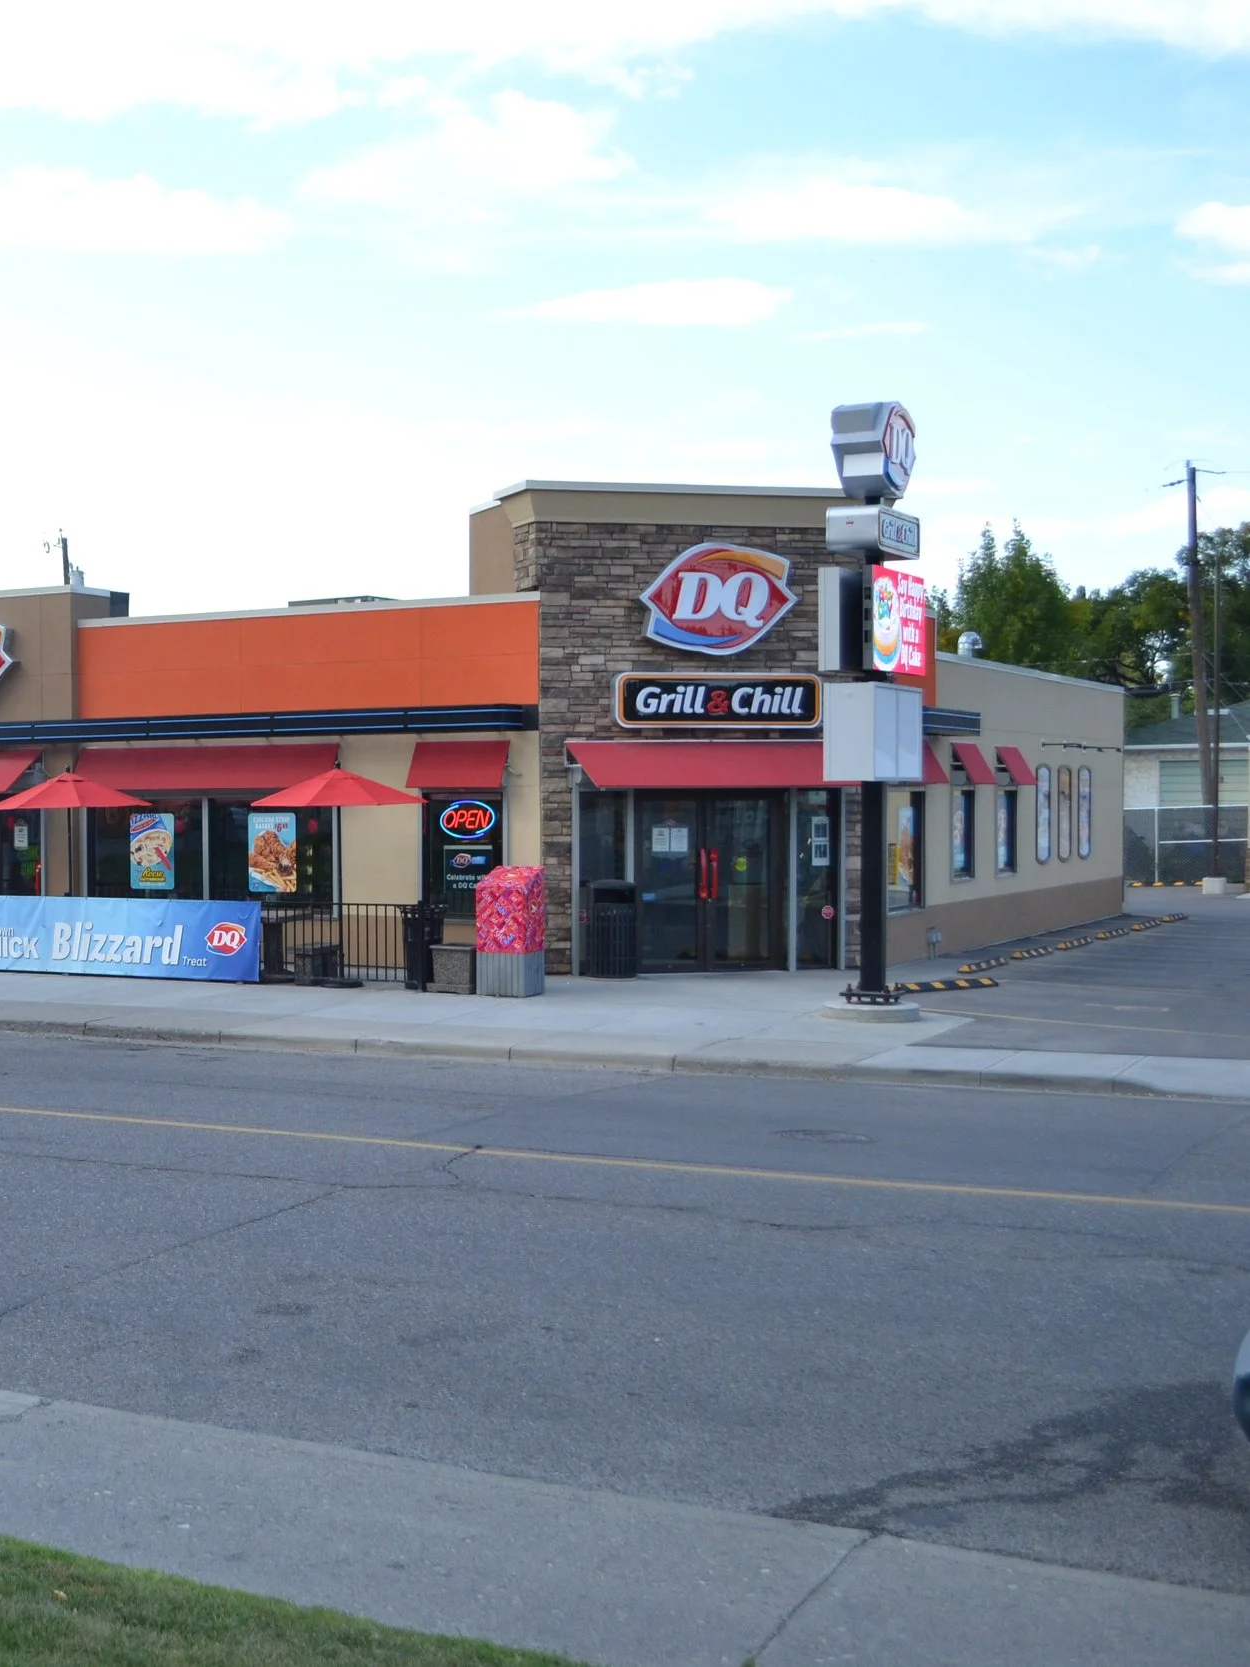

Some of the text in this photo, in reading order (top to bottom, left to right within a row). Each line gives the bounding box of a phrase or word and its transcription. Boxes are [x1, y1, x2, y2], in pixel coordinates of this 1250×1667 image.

[891, 423, 913, 477] DQ
[672, 571, 770, 629] DQ
[899, 597, 923, 627] Birthday
[909, 645, 922, 668] Cake
[635, 686, 706, 714] Grill
[731, 686, 804, 714] Chill
[443, 810, 490, 828] OPEN
[52, 921, 185, 966] Blizzard
[182, 956, 208, 967] Treat
[212, 929, 240, 950] DQ
